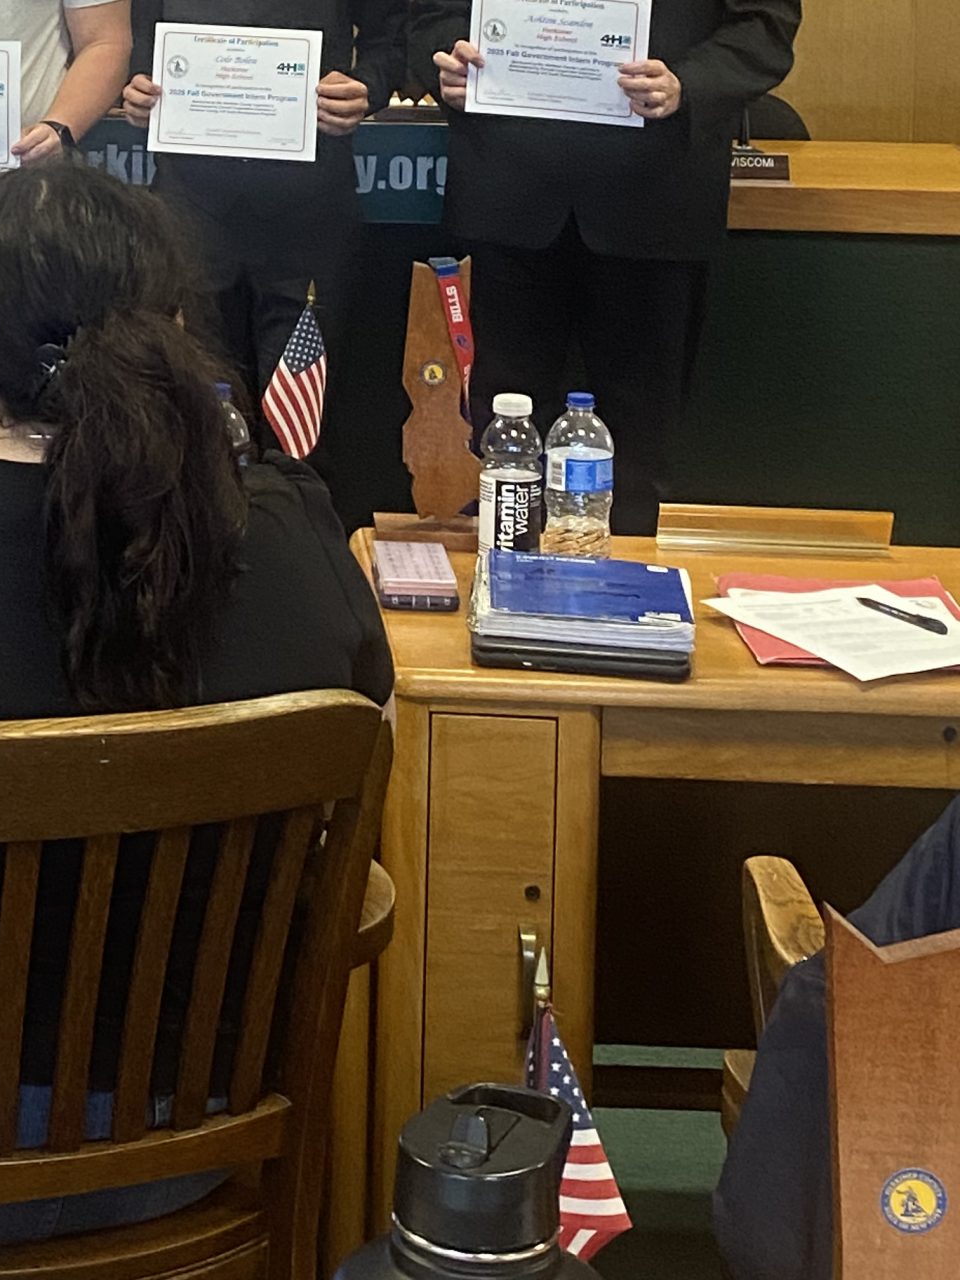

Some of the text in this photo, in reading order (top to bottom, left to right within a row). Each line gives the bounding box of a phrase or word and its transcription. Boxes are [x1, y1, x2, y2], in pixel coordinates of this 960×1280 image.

[195, 36, 227, 44] Certificate
[237, 38, 280, 47] Participation
[522, 51, 567, 62] Government
[202, 91, 244, 99] Government
[268, 94, 299, 102] Program
[446, 285, 463, 323] BILLS
[515, 484, 530, 536] water
